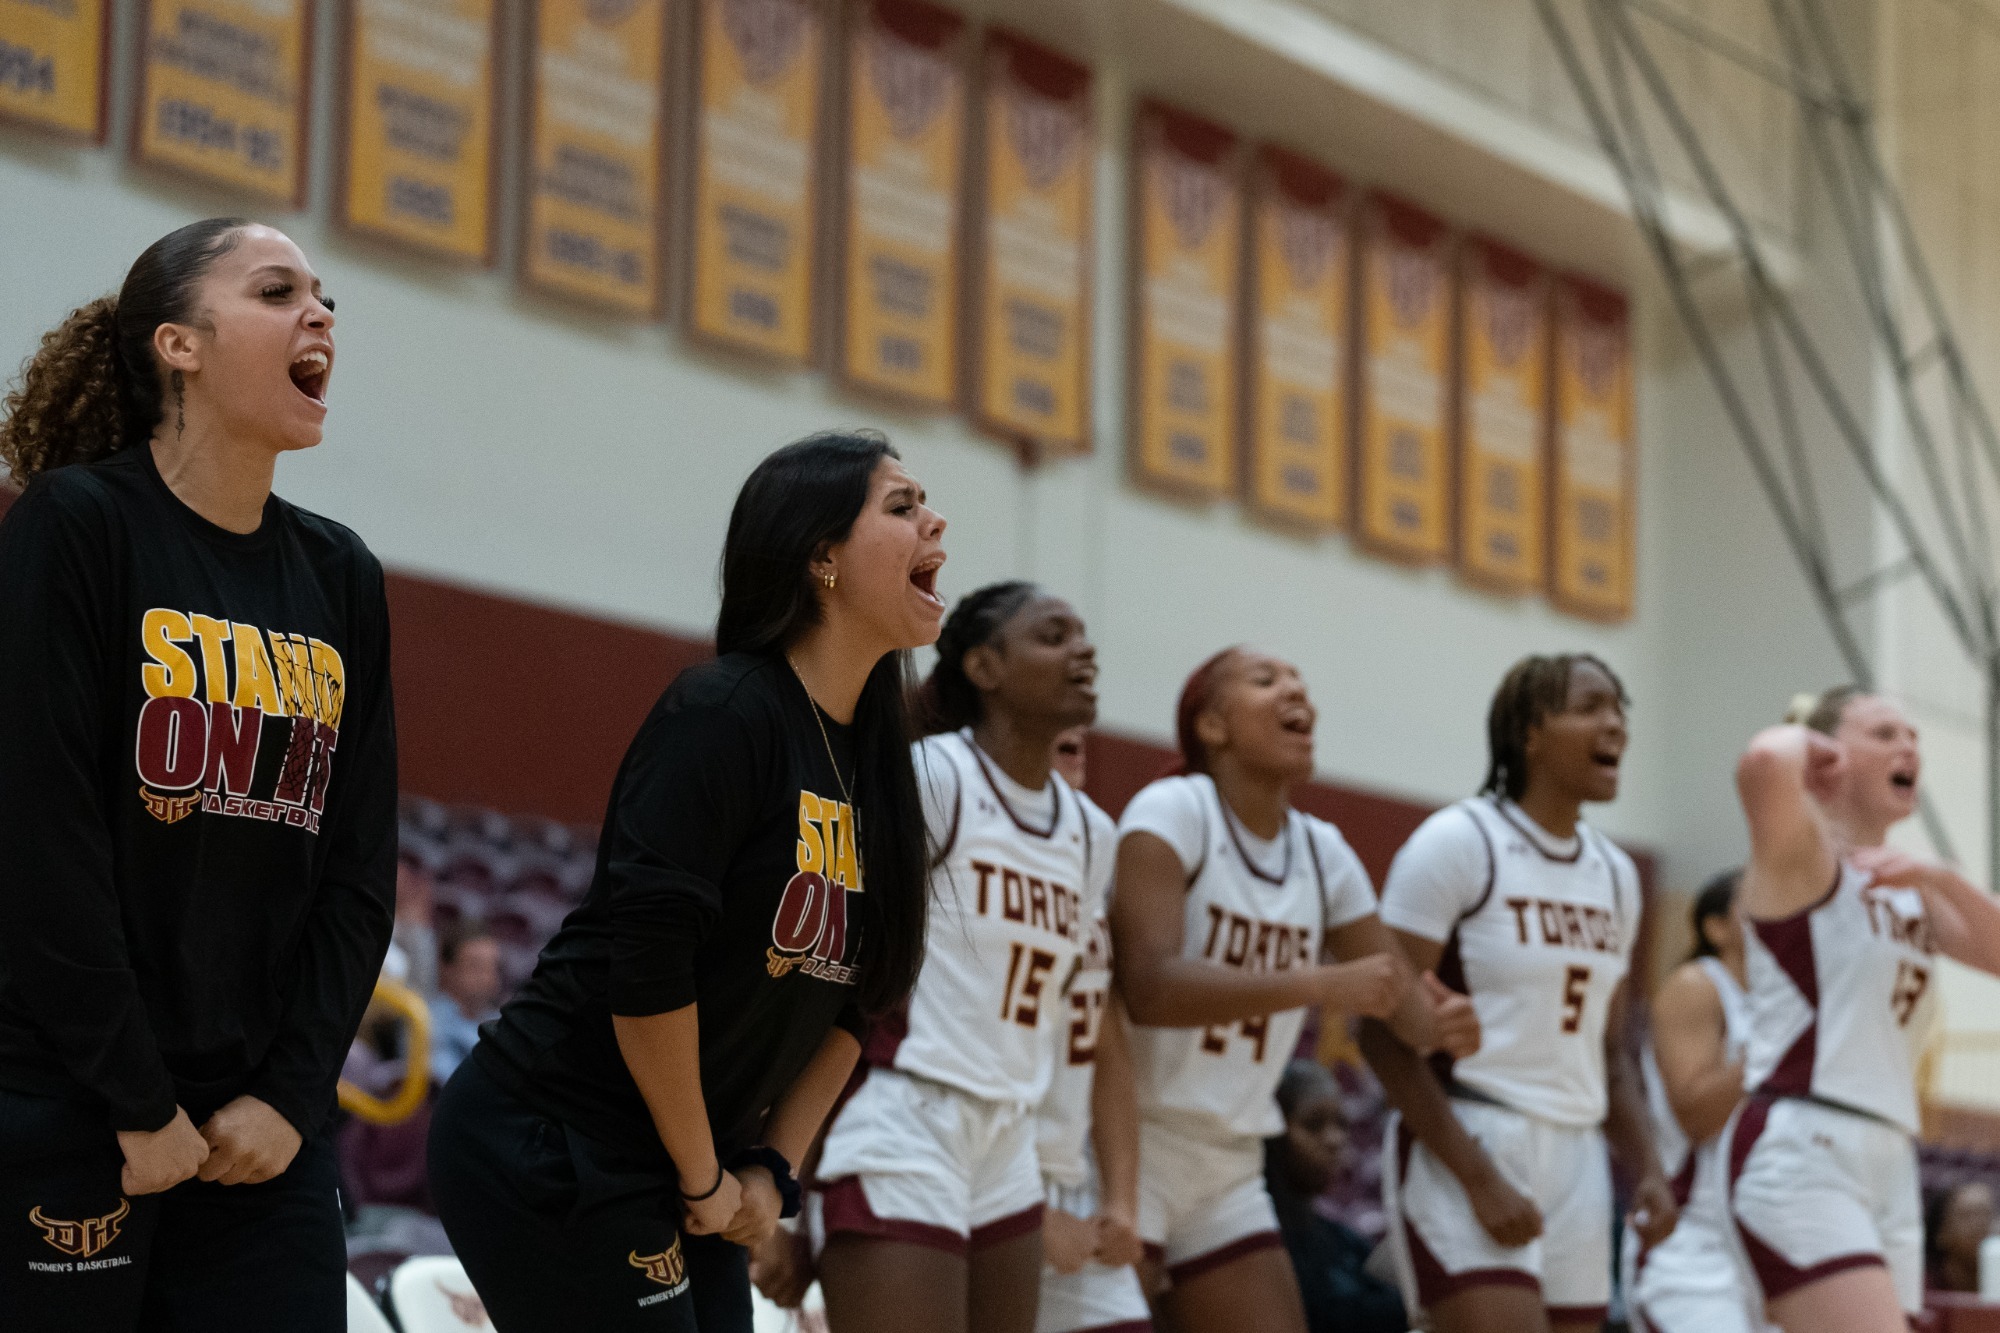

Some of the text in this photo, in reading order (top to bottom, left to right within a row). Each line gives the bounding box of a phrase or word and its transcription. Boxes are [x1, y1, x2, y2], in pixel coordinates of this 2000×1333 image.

[142, 608, 345, 731] STAND
[136, 696, 338, 816] ON IT
[772, 871, 847, 965] ON
[1000, 941, 1056, 1029] 15
[1561, 965, 1592, 1034] 5
[28, 1255, 132, 1273] WOMEN'S BASKETBALL
[637, 1288, 675, 1307] WOMEN'S
